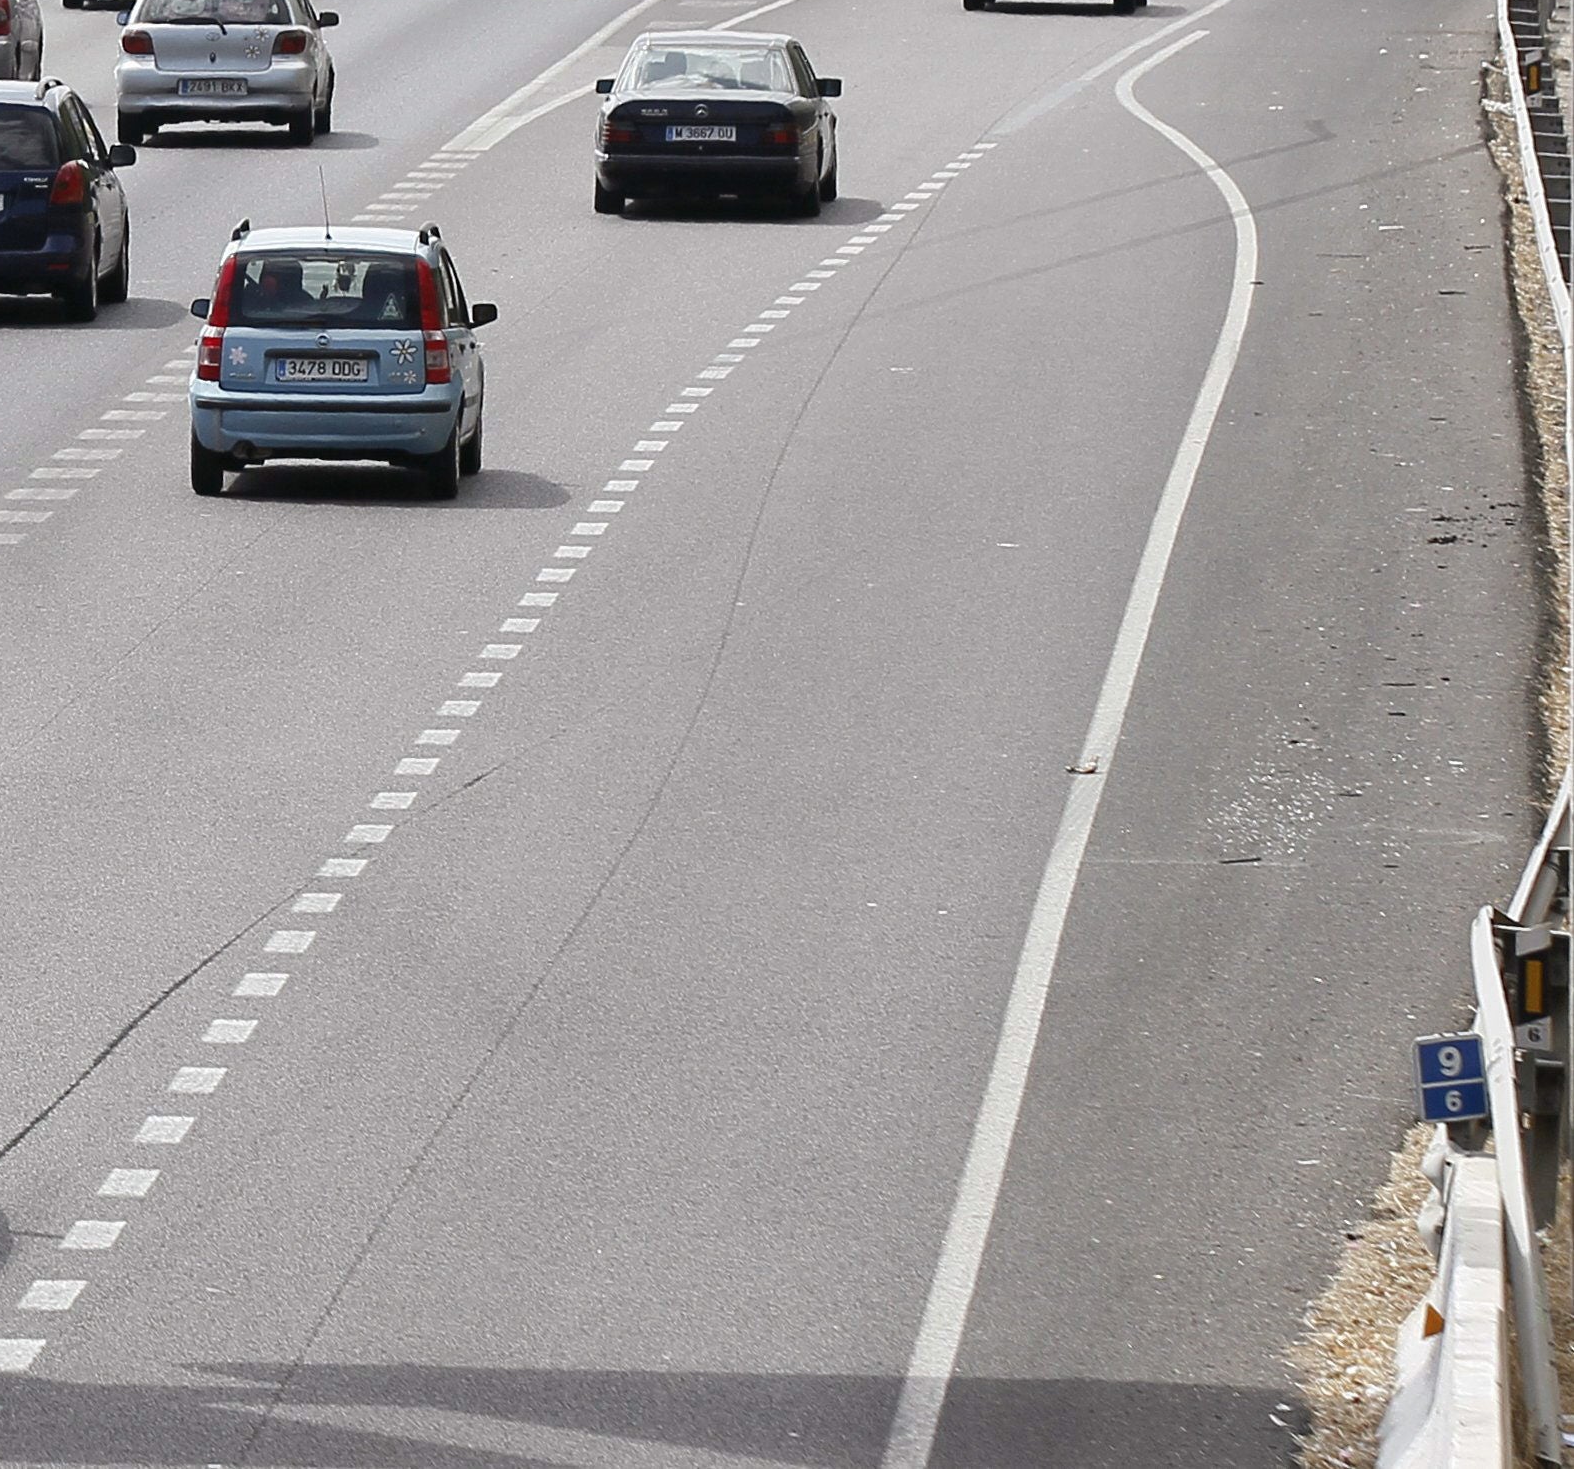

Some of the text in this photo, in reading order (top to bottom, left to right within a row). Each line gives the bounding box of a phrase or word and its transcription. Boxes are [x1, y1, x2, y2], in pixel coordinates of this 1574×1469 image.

[288, 361, 326, 376] 3478
[1439, 1046, 1462, 1077] 9
[1445, 1090, 1463, 1112] 6
